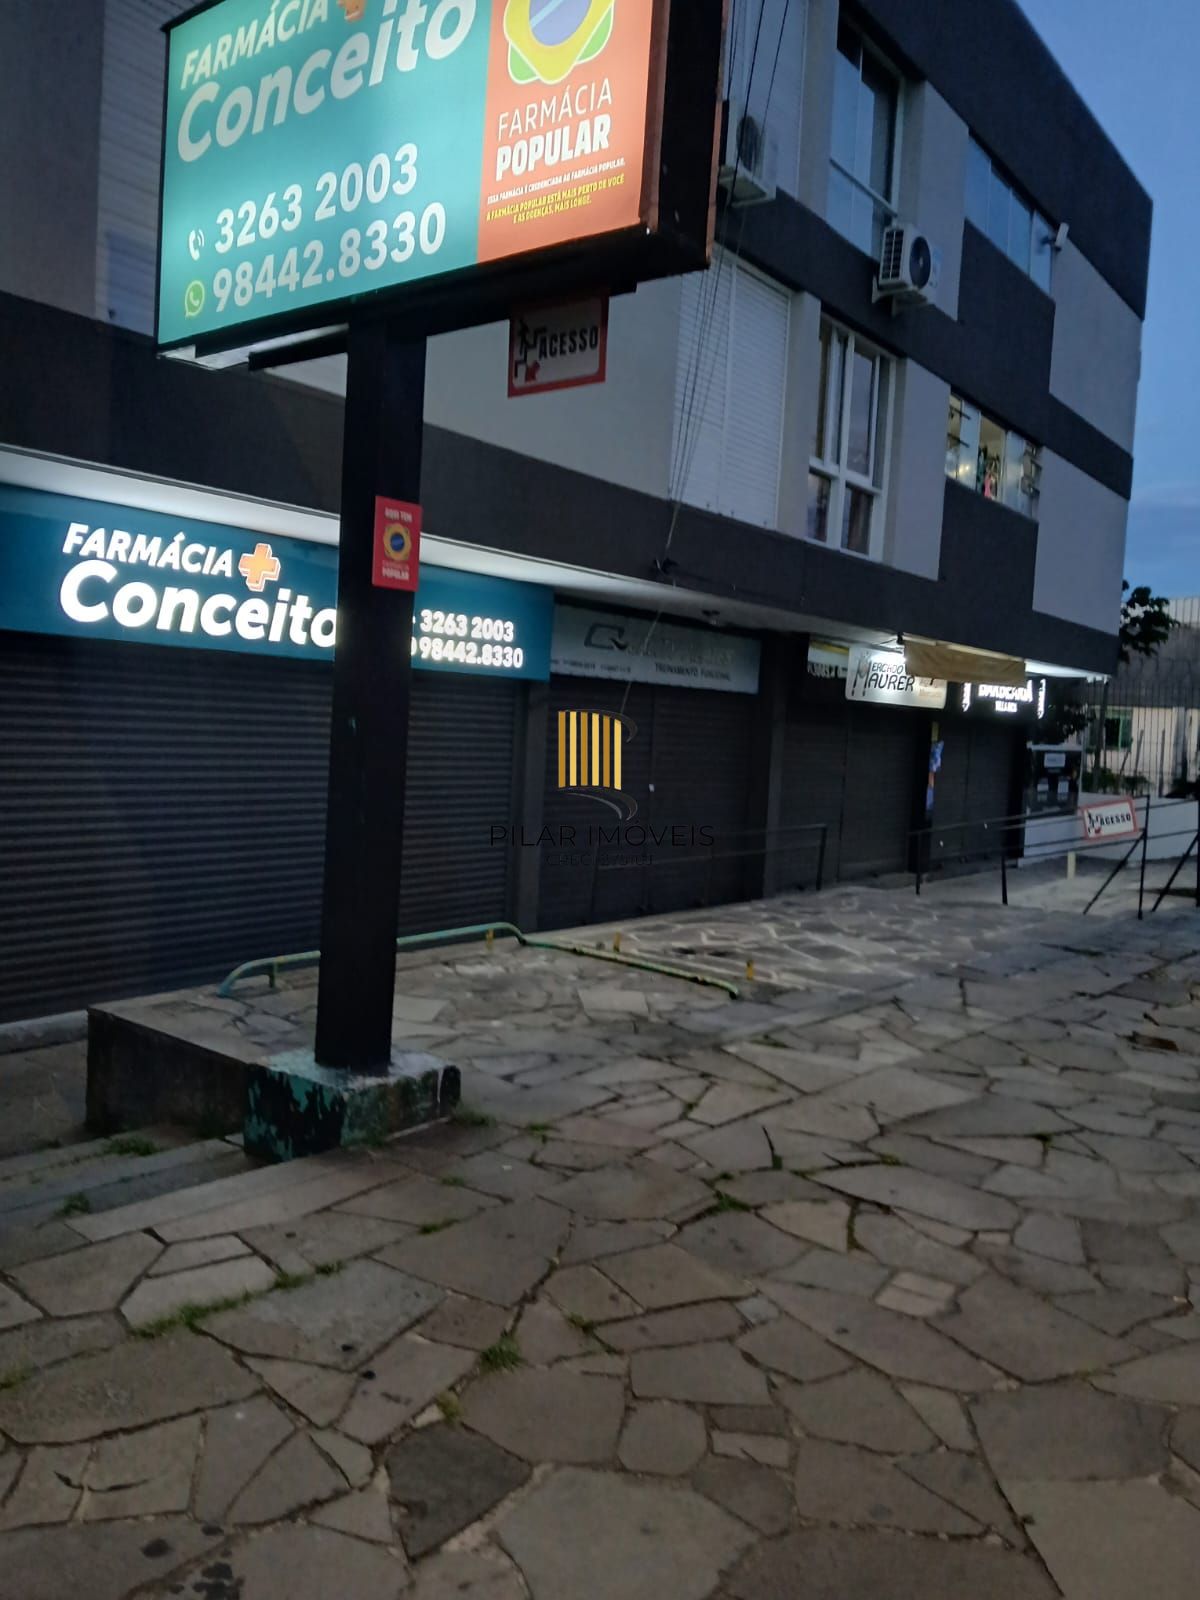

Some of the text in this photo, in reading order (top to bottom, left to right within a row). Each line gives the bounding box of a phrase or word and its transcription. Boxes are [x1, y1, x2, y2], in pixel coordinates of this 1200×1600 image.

[181, 0, 328, 89] FARMÁCIA
[178, 0, 476, 162] Conceito
[498, 78, 612, 141] FARMÁCIA
[496, 114, 611, 181] POPULAR
[215, 143, 418, 253] 3263 2003
[213, 202, 446, 312] 98442.8330
[538, 326, 598, 361] ACESSO
[62, 522, 232, 577] FARMÁCIA
[60, 559, 336, 648] Conceito
[420, 609, 514, 642] 3263 2003
[420, 636, 524, 668] 98442.8330
[1100, 813, 1131, 826] ACESSO
